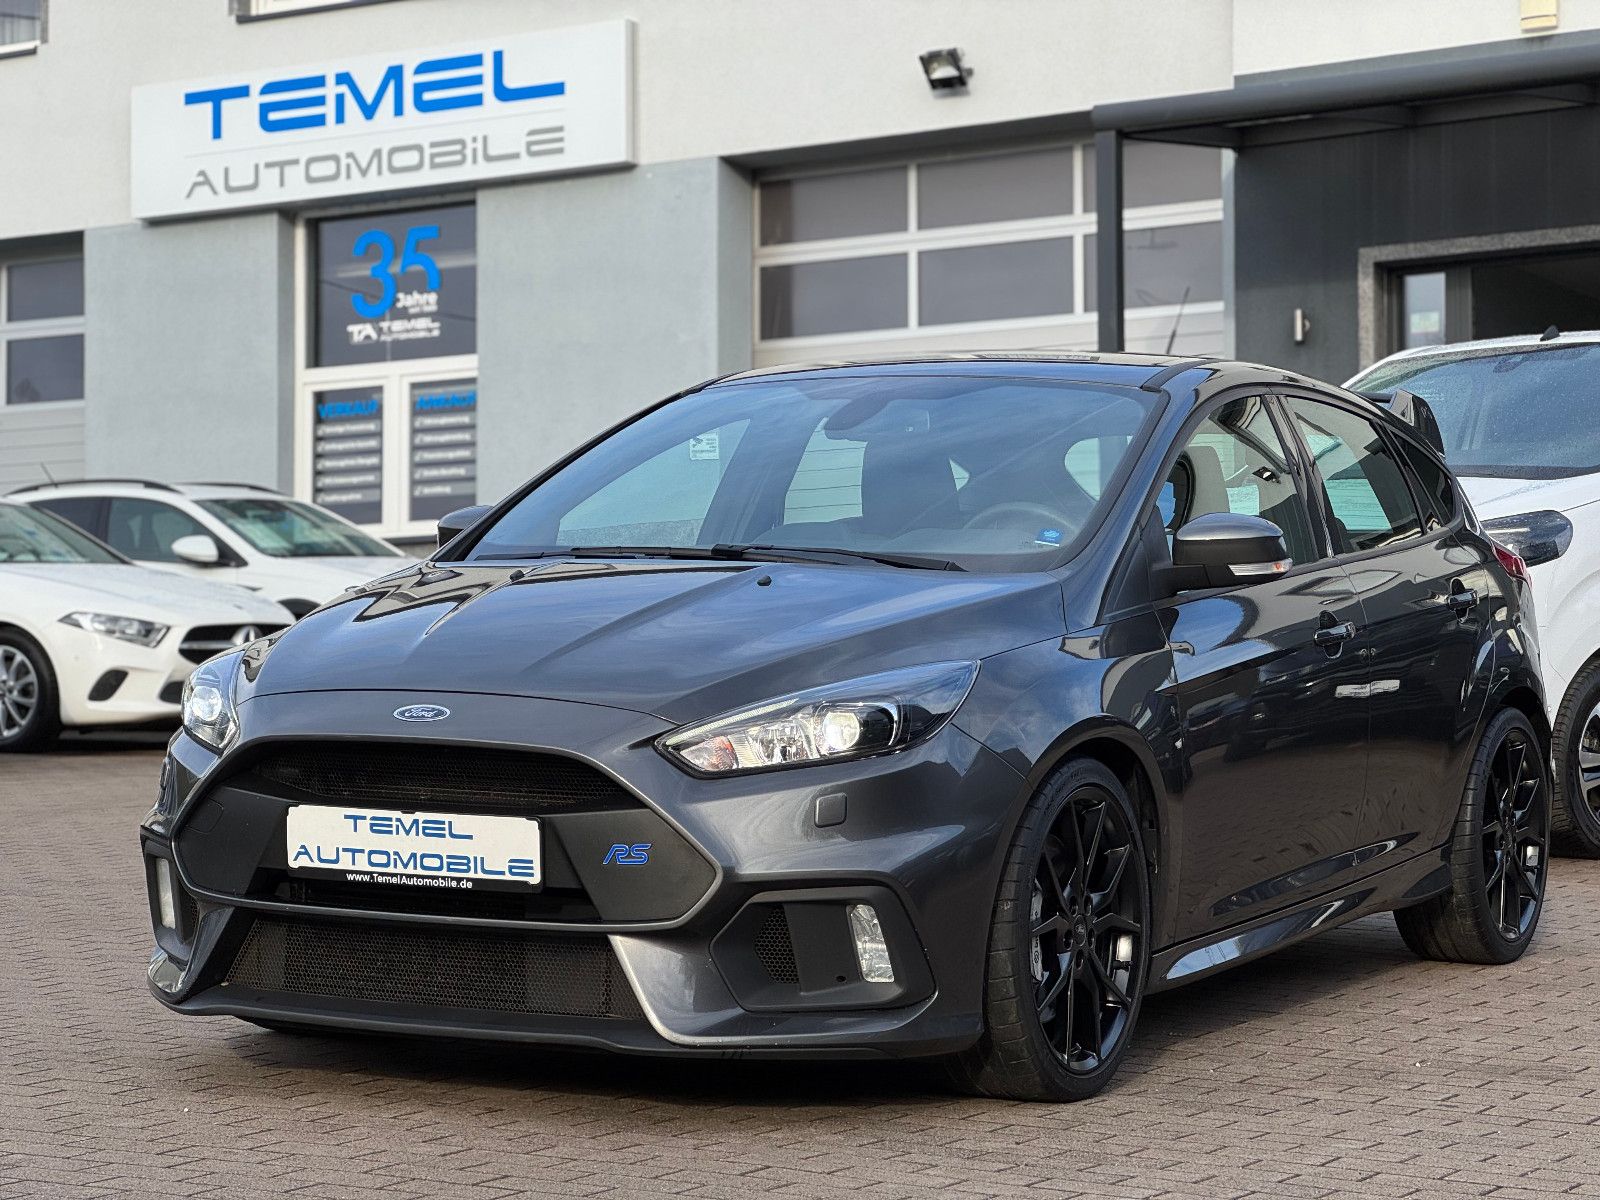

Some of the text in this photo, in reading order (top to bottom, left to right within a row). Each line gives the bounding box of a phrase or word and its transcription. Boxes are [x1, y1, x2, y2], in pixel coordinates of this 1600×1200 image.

[184, 50, 566, 141] TEMEL
[351, 225, 442, 319] 35
[396, 290, 438, 308] Jahre
[404, 707, 439, 718] Ford
[343, 814, 474, 841] TEMEL
[292, 844, 535, 878] AUTOMOBILE
[602, 843, 652, 865] RS
[346, 873, 473, 889] www.TemelAutomobile.de
